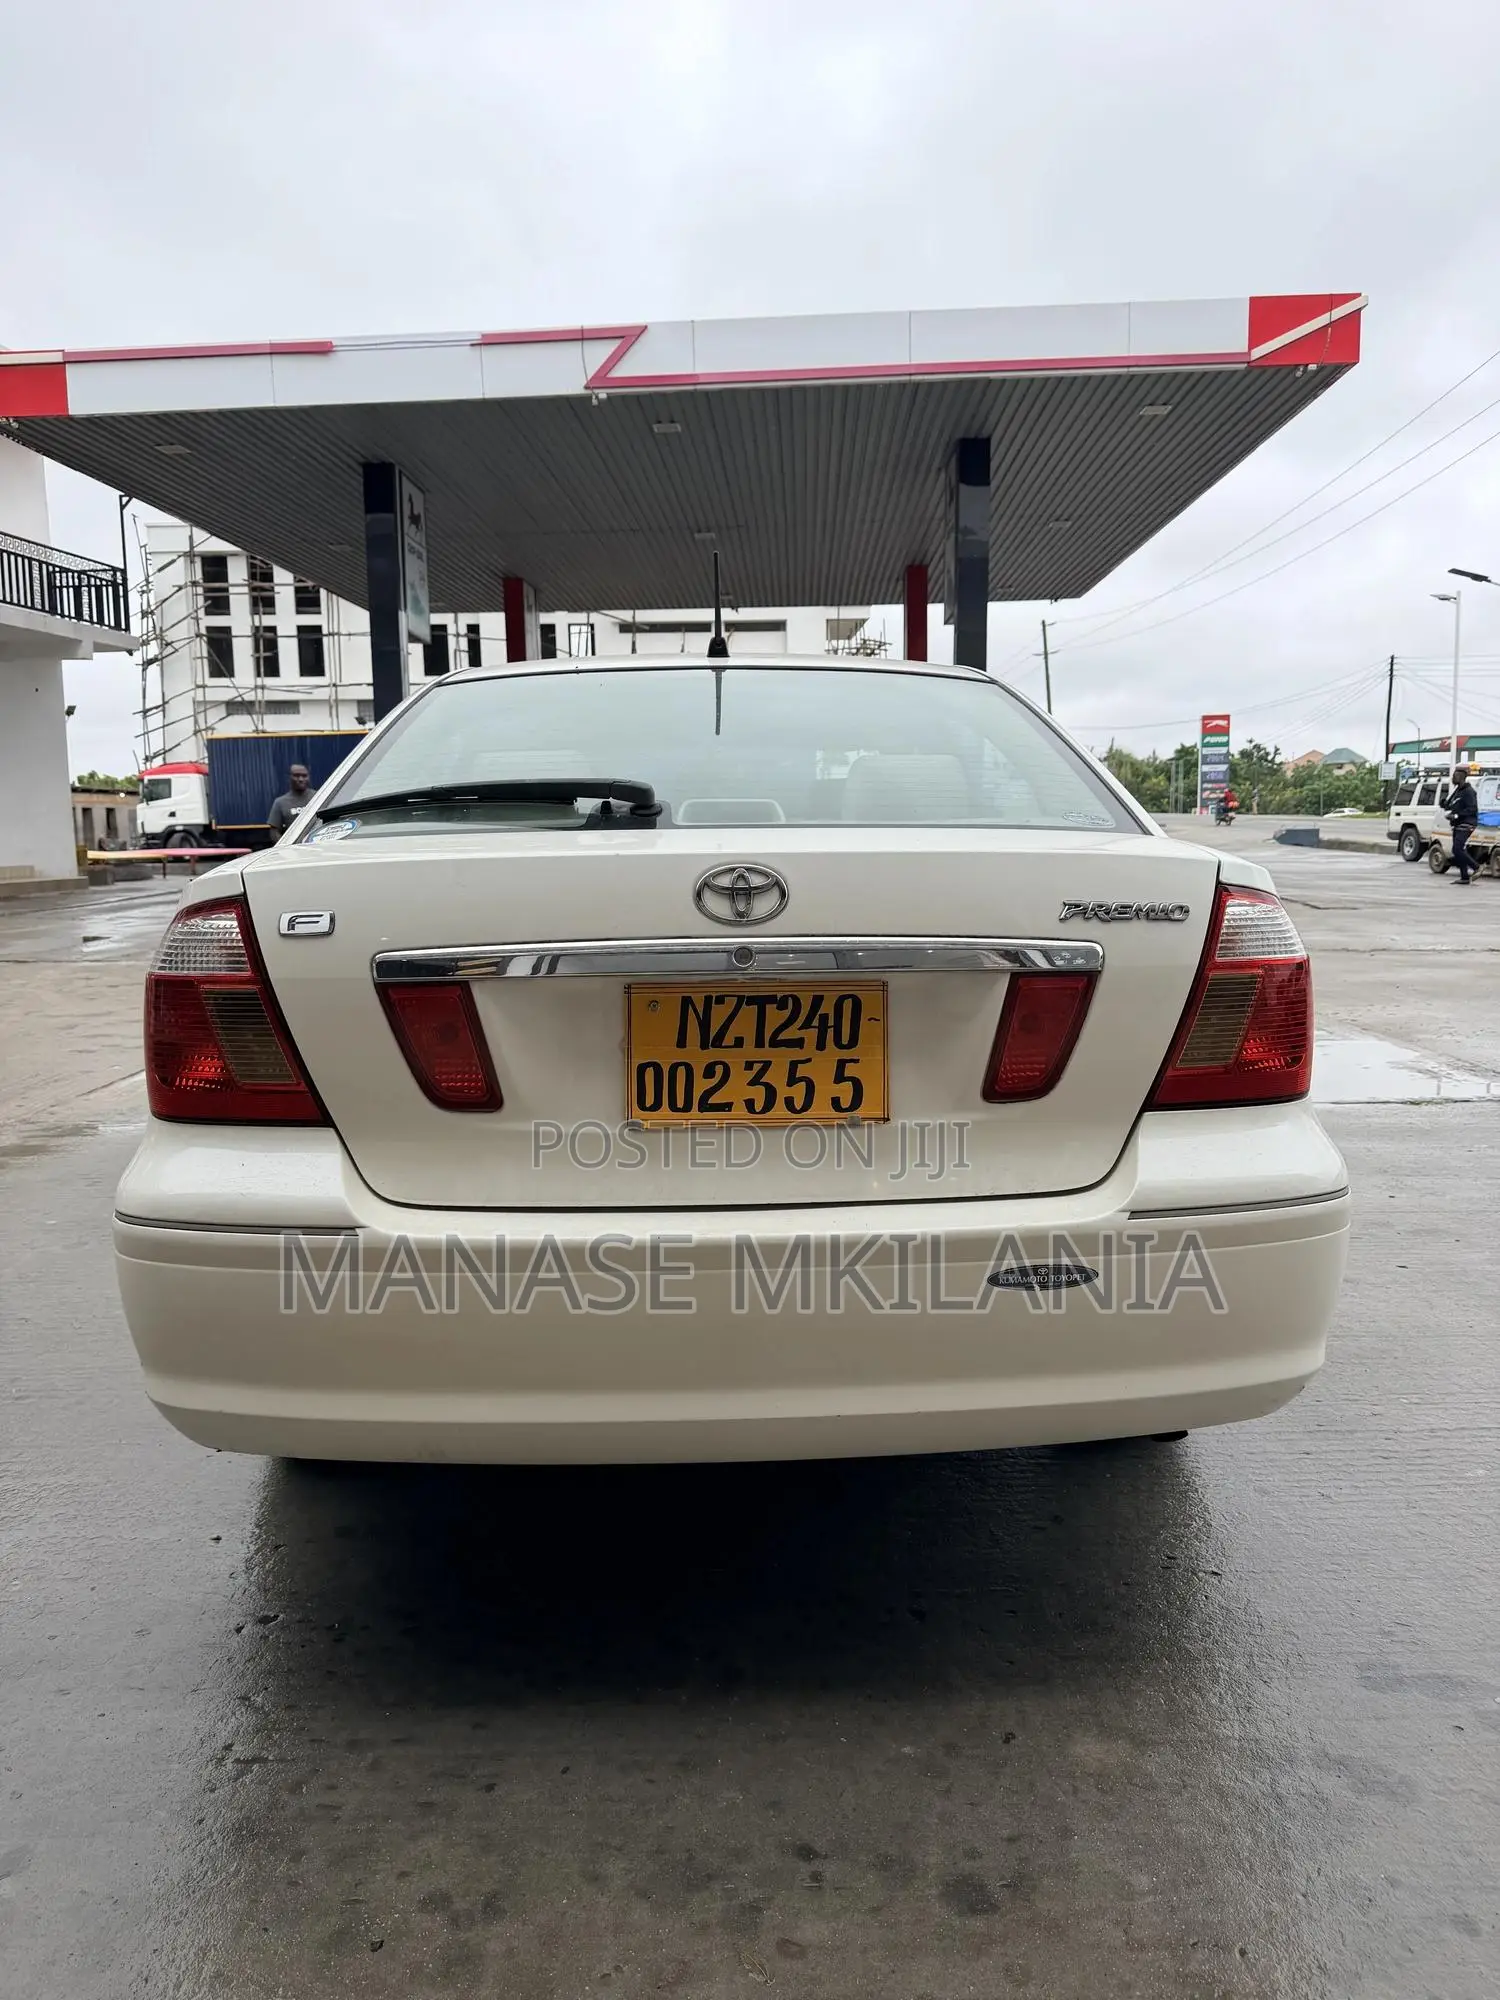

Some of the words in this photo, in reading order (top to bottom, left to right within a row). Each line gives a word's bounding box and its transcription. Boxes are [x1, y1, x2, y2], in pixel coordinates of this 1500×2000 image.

[1059, 900, 1191, 922] PREMIO
[286, 914, 324, 932] F
[676, 993, 862, 1051] NZT240
[999, 1275, 1047, 1284] KUMAMOTO
[1051, 1273, 1085, 1282] TOYOPET
